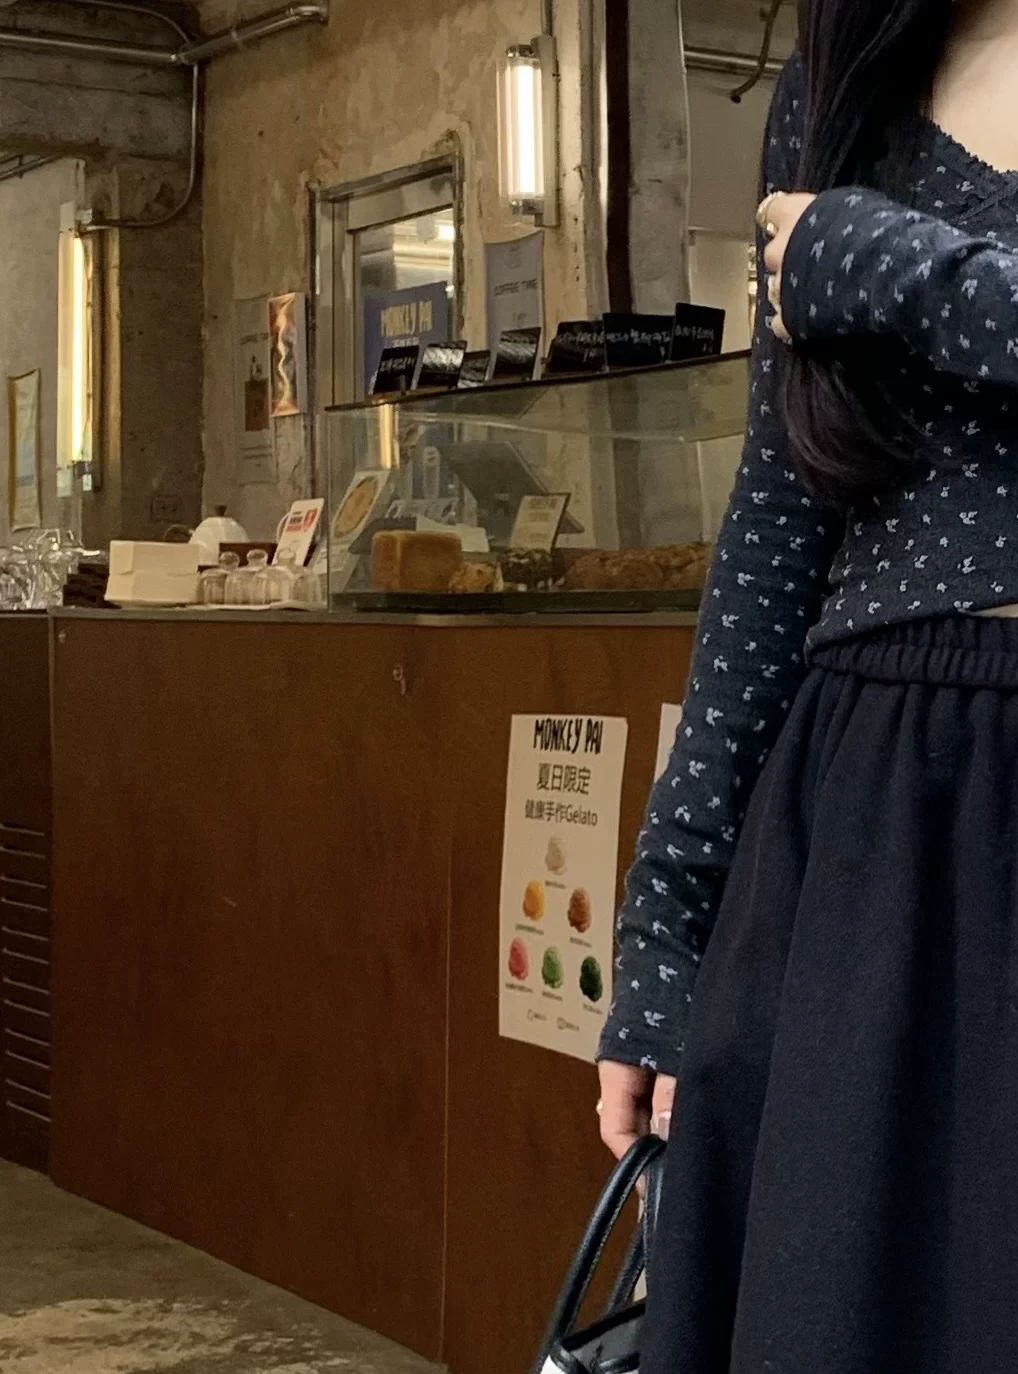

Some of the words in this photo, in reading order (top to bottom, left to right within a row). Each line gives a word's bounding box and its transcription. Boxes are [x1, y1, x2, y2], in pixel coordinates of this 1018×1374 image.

[533, 717, 583, 755] MONKEY
[537, 762, 592, 796] 夏日限定
